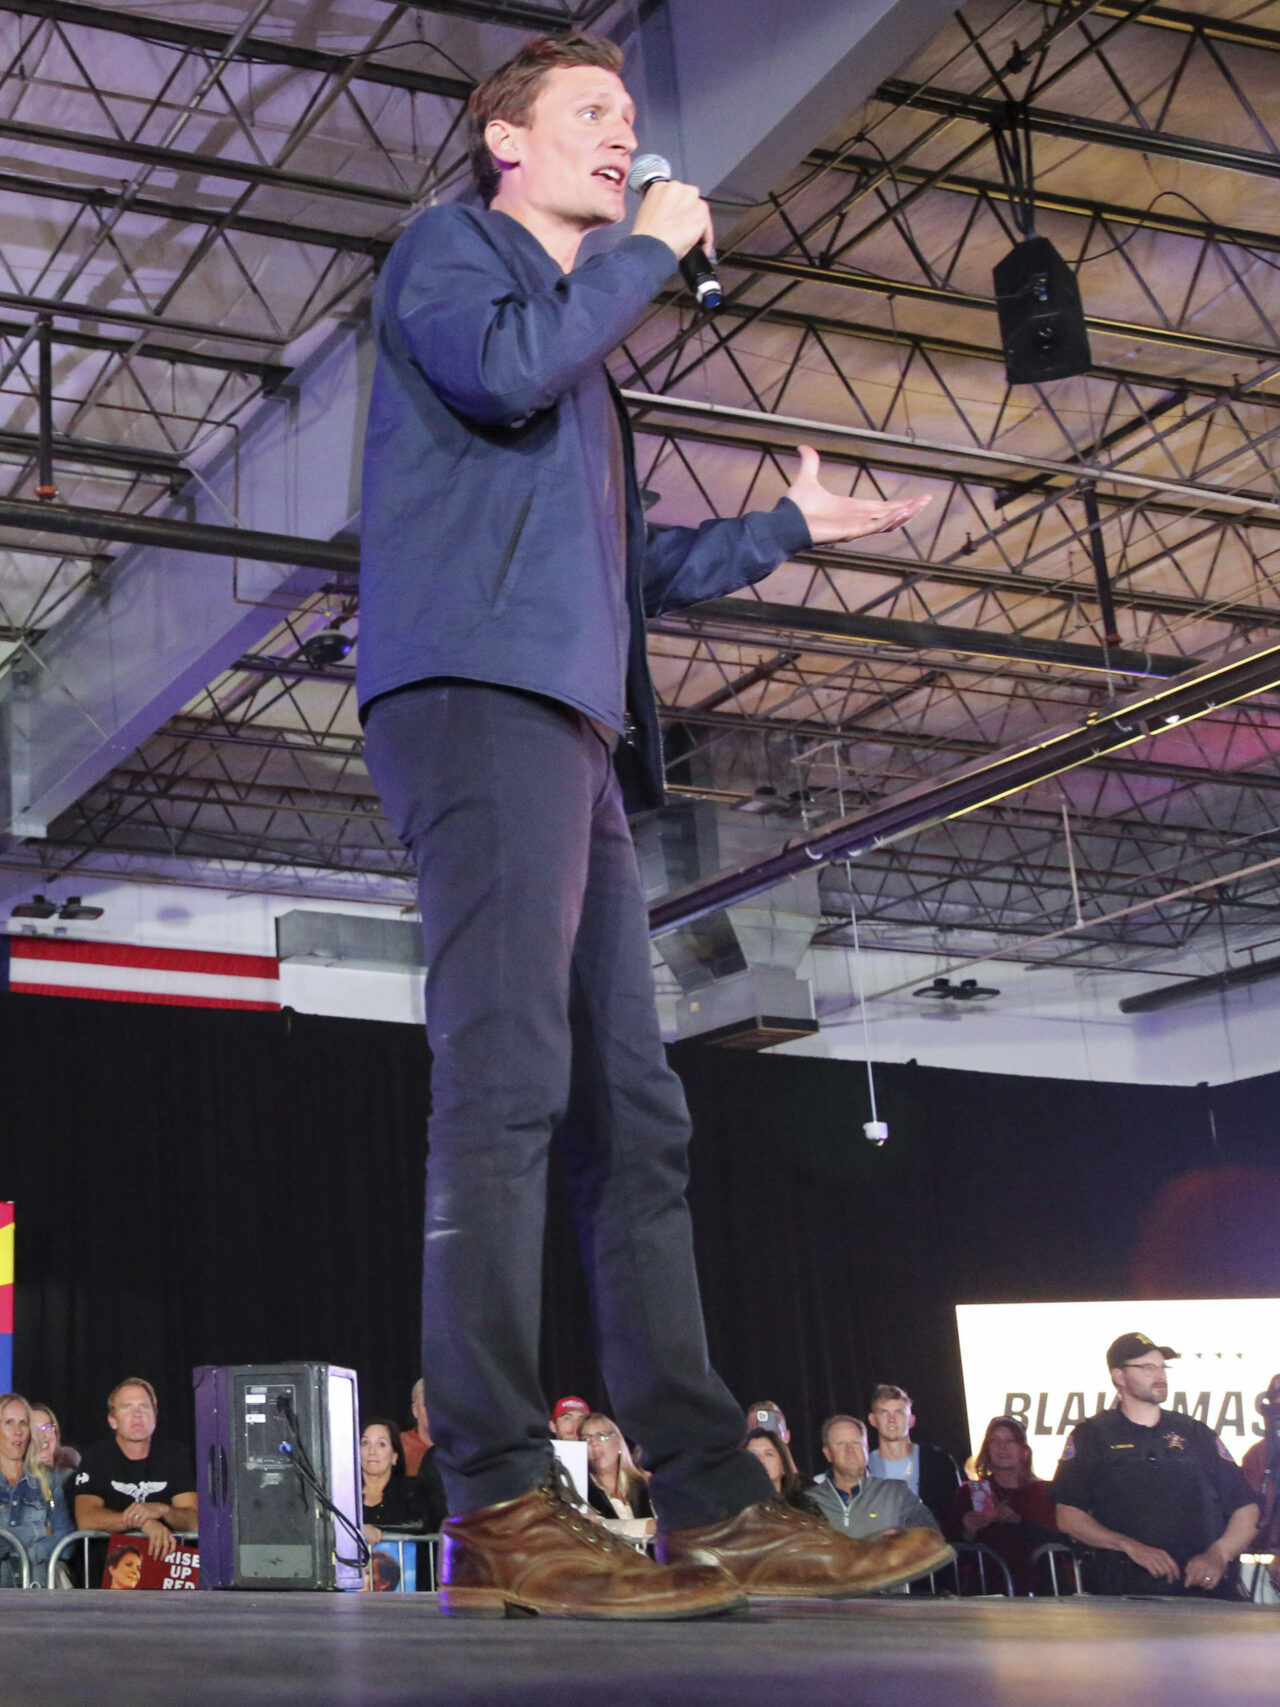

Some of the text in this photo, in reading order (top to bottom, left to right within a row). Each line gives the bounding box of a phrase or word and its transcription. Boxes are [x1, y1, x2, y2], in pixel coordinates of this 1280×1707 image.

[165, 1552, 200, 1568] RISE
[170, 1565, 192, 1579] UP
[163, 1578, 195, 1589] RED
